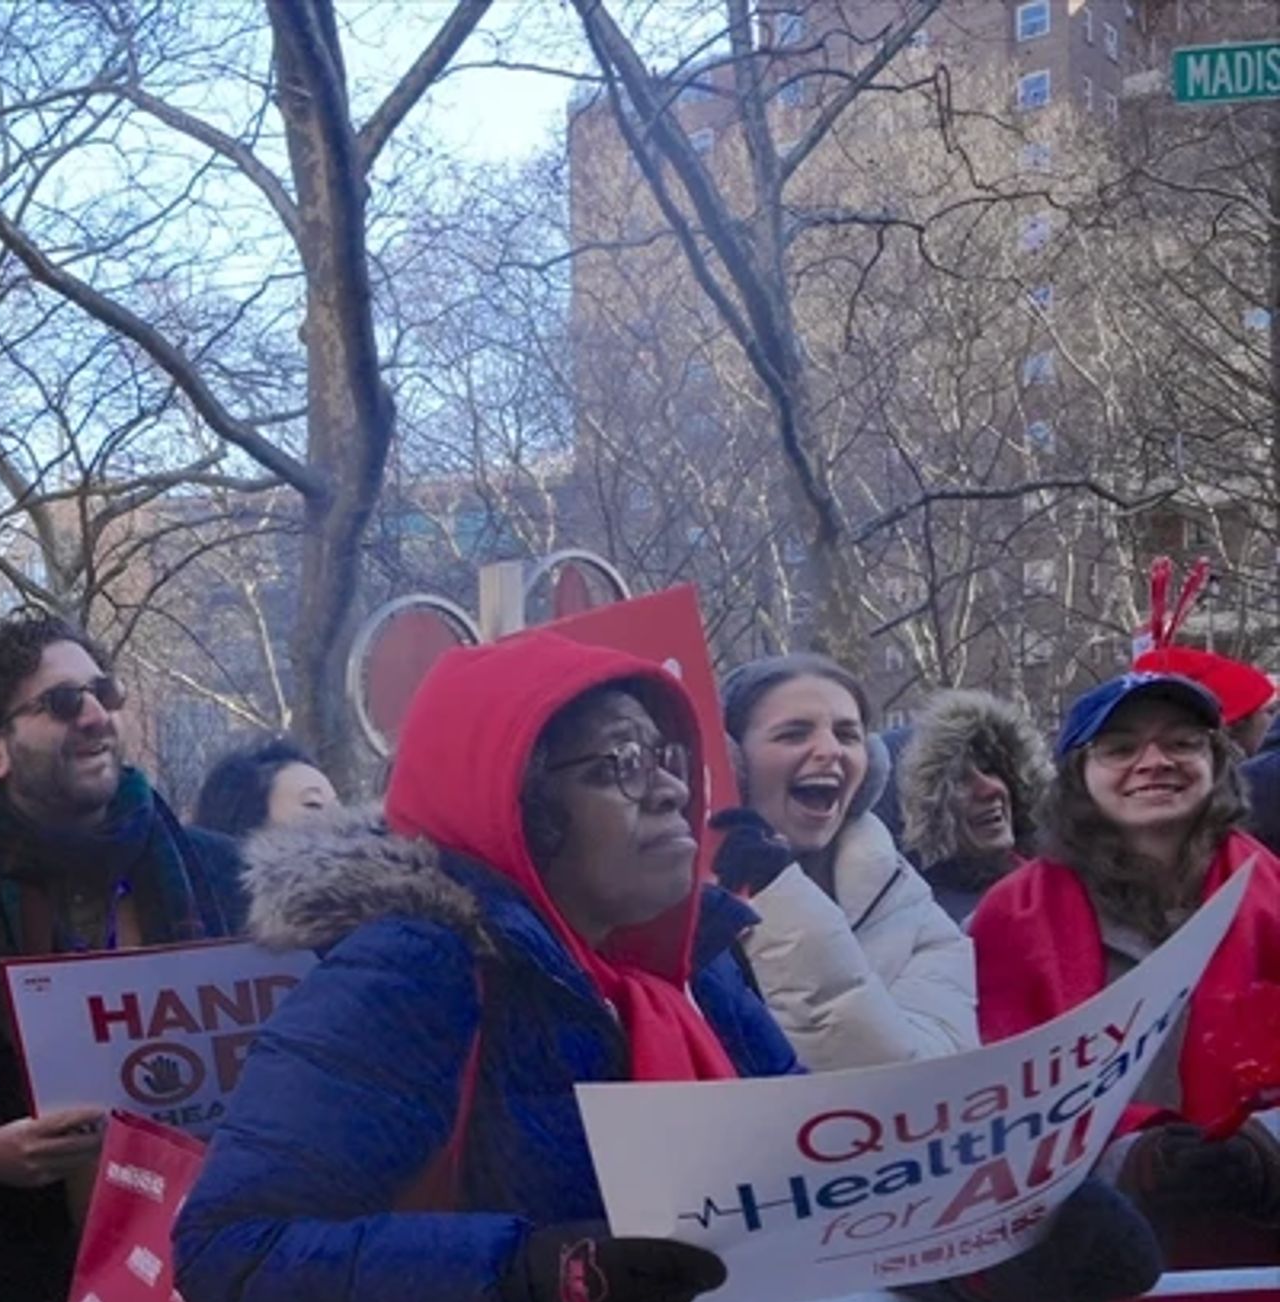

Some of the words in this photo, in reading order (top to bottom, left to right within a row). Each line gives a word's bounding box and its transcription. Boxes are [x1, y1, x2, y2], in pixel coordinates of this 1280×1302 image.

[1187, 48, 1280, 96] MADIS
[88, 974, 301, 1044] HAND
[120, 1030, 257, 1106] OF
[796, 997, 1144, 1163] Quality
[820, 1196, 932, 1246] for
[932, 1105, 1096, 1229] All
